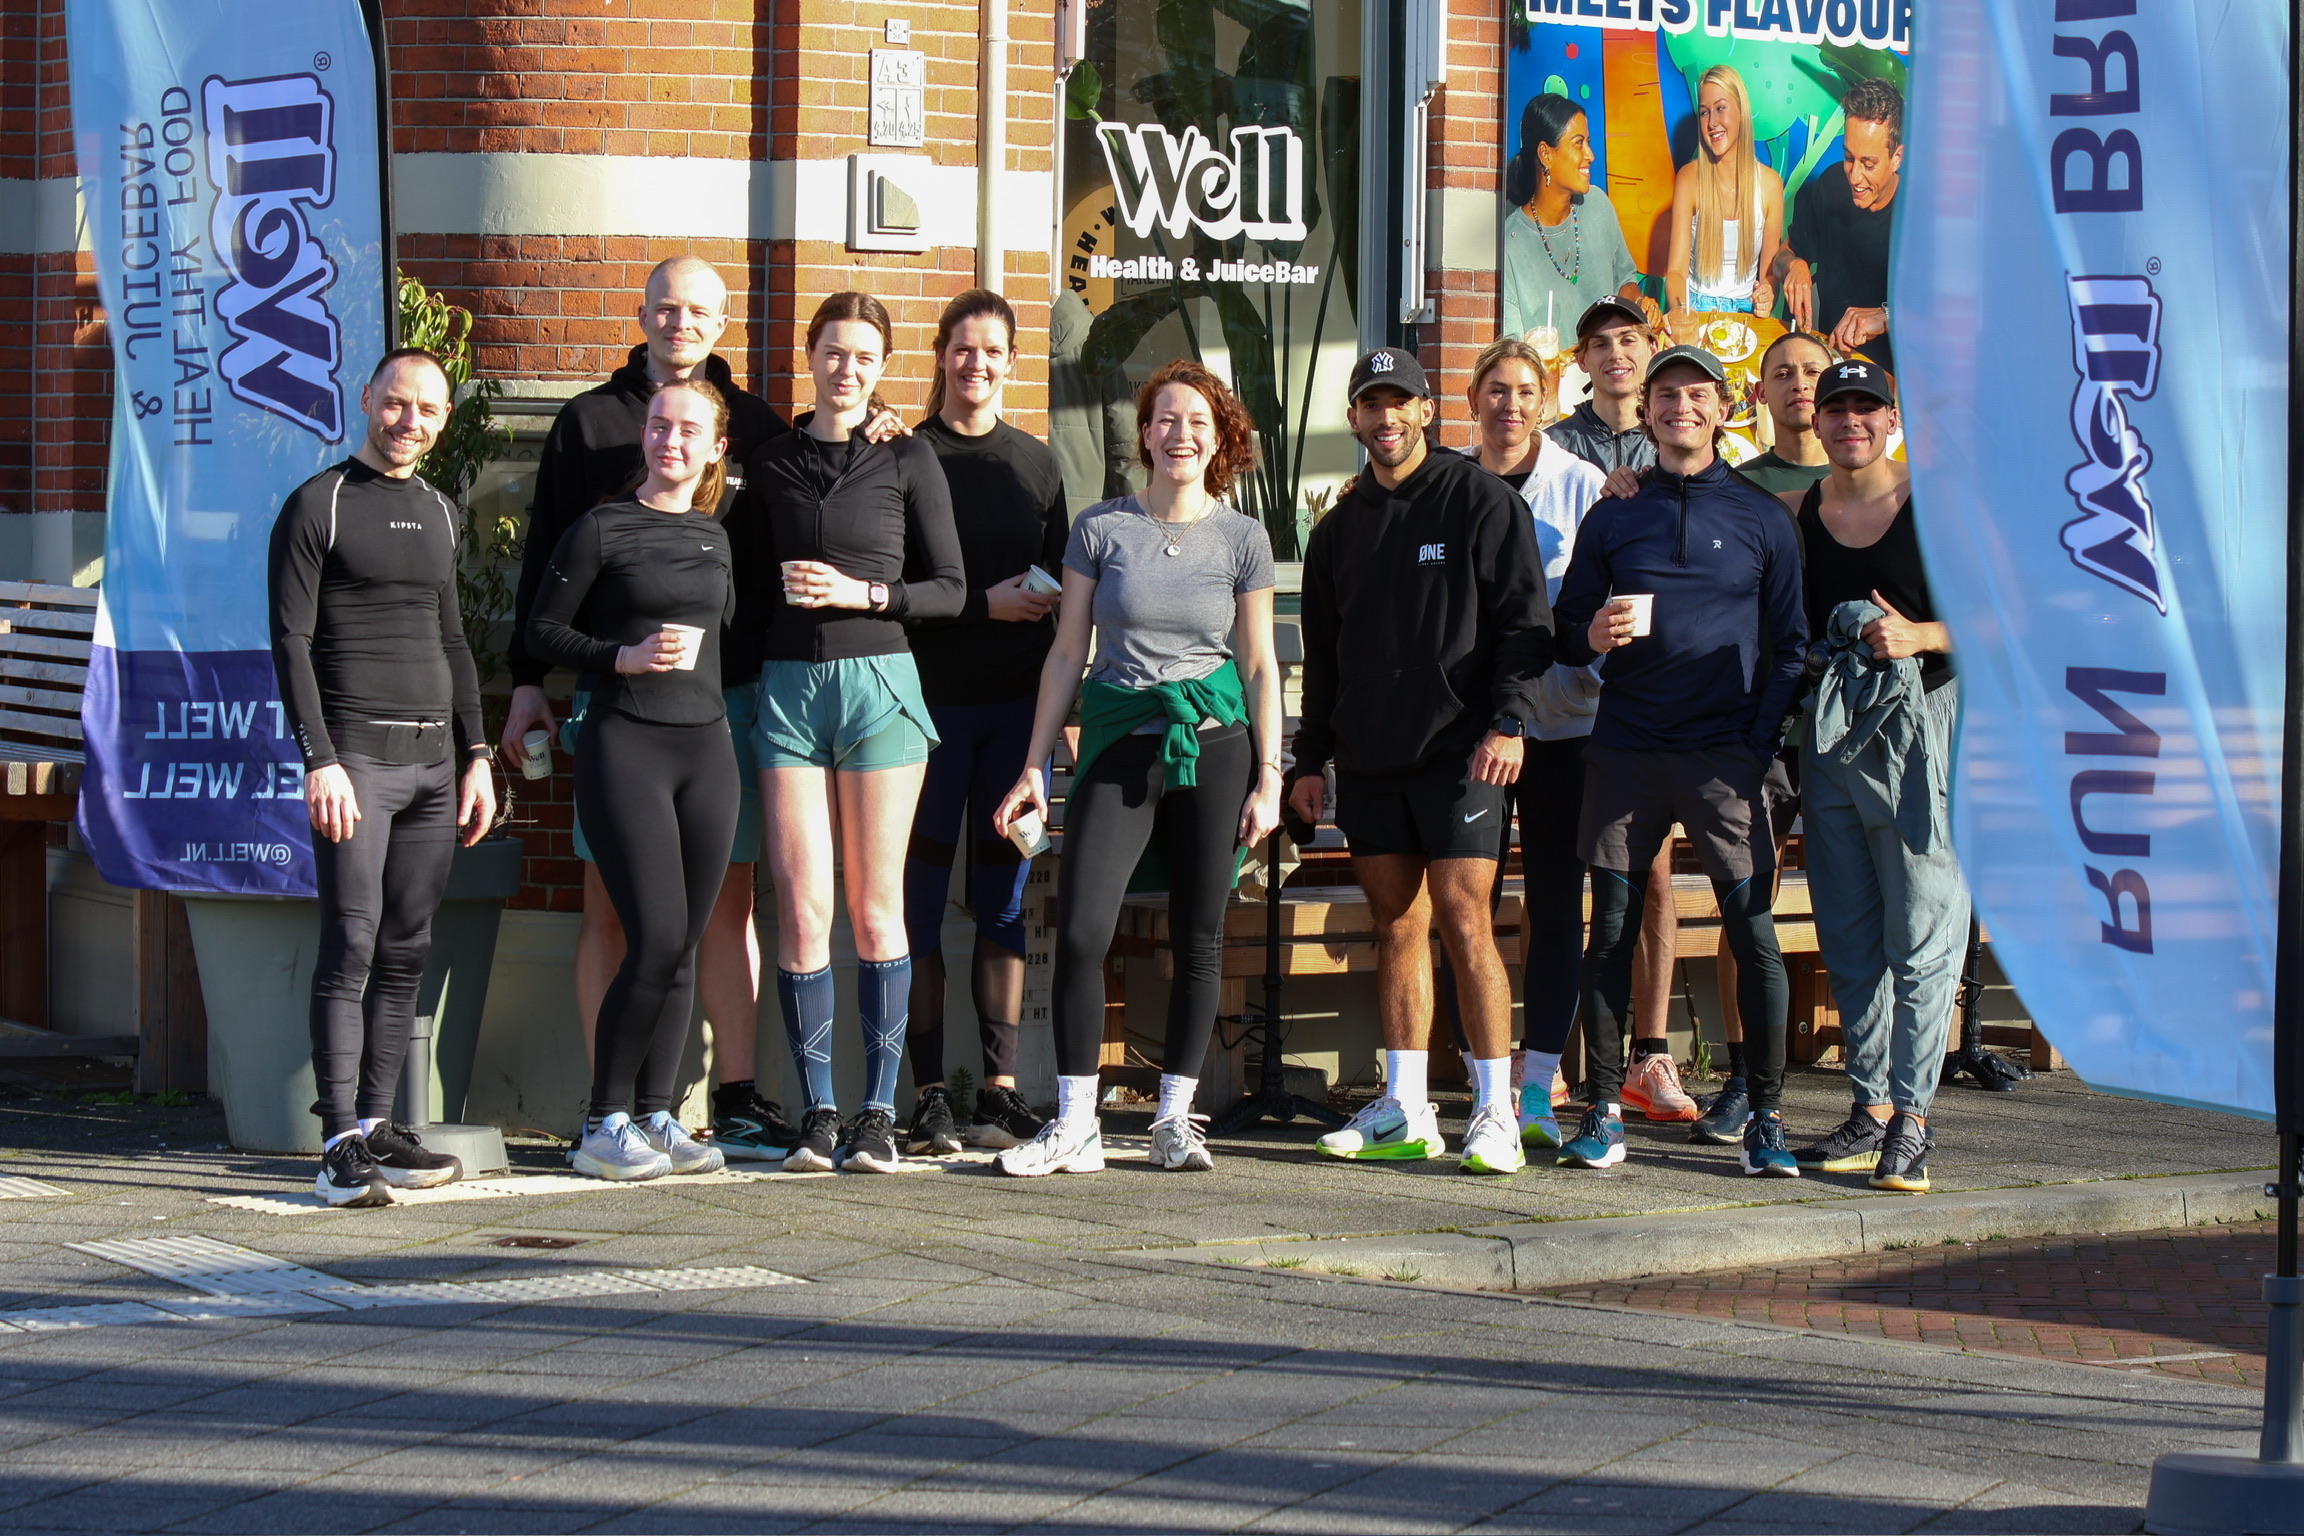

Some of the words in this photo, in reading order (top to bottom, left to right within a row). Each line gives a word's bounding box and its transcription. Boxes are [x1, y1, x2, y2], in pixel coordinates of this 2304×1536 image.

[1096, 122, 1307, 241] Well
[1090, 255, 1173, 279] Health
[1180, 257, 1200, 281] &
[1206, 259, 1319, 284] JuiceBar
[390, 521, 422, 530] KIPSTA
[299, 723, 313, 757] KIPSTA
[1029, 871, 1050, 884] 228
[1027, 953, 1048, 966] 228
[1034, 1007, 1048, 1020] HT
